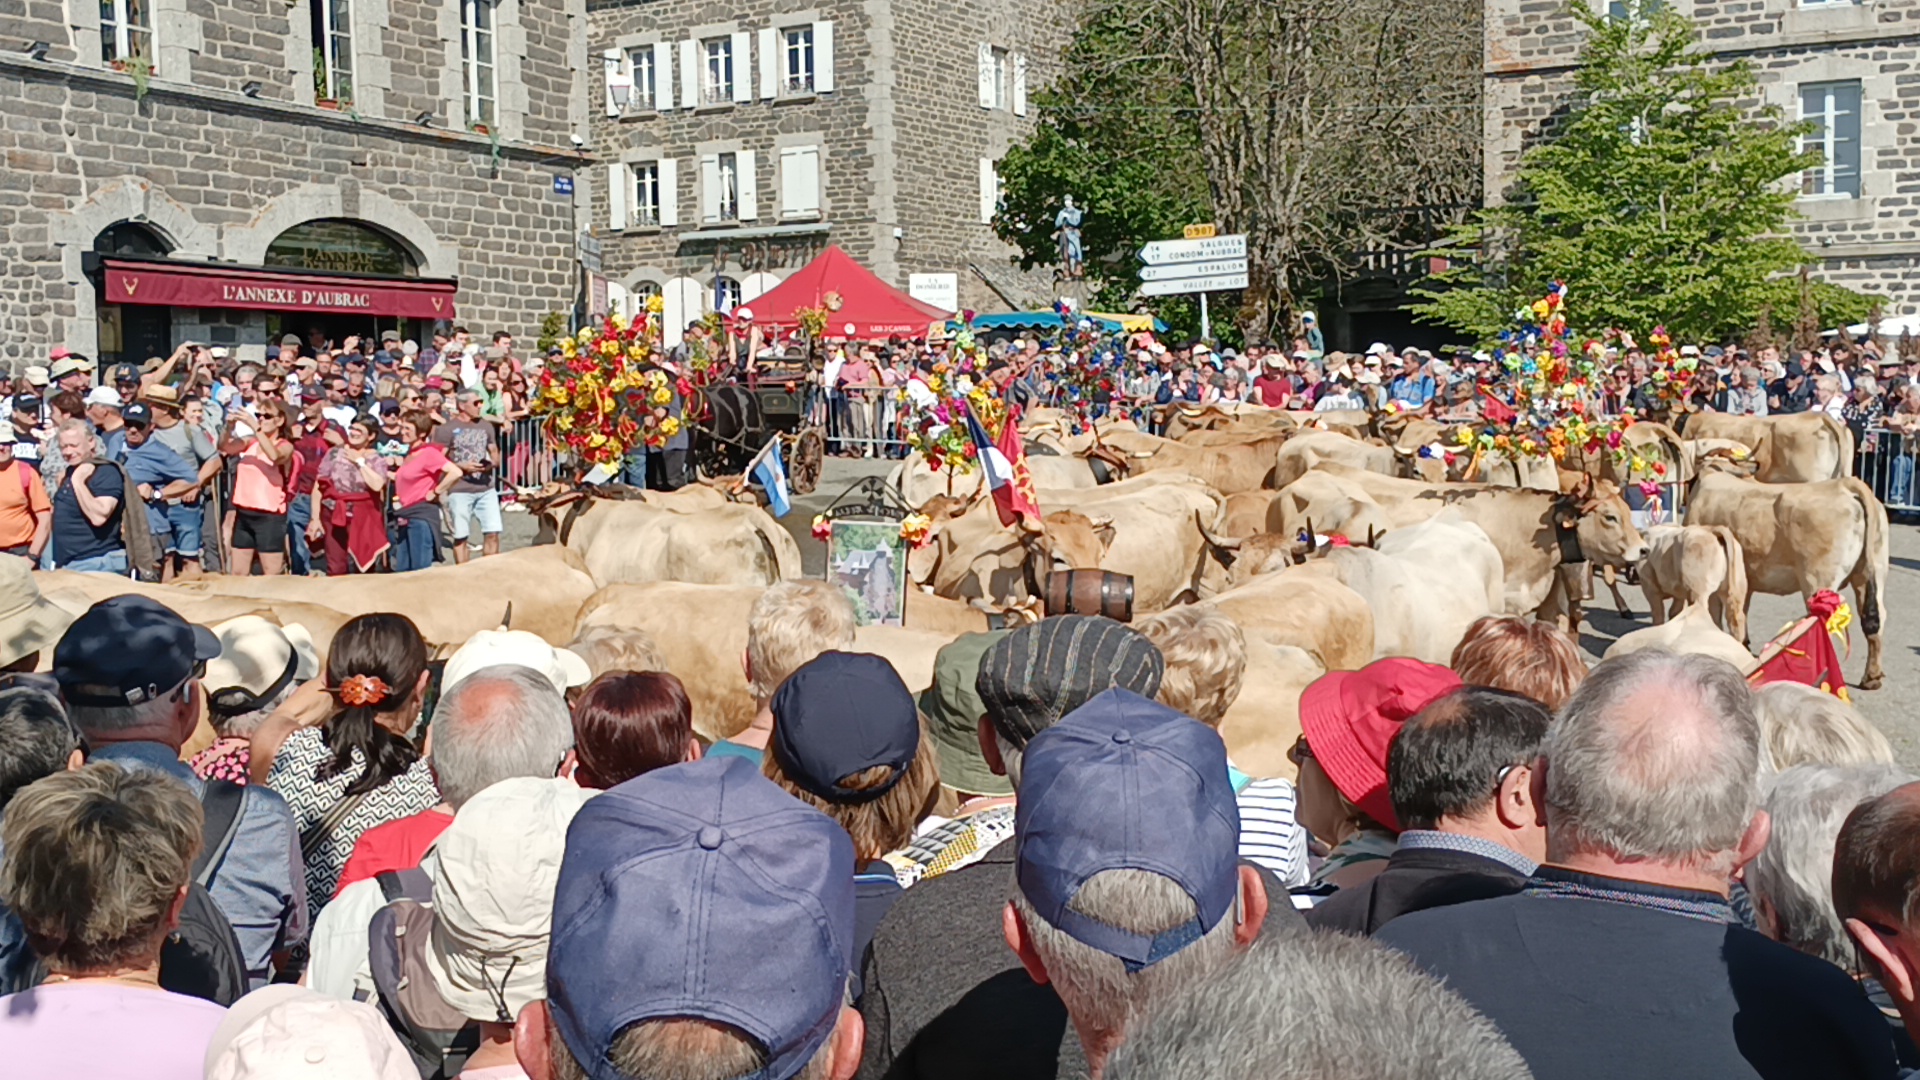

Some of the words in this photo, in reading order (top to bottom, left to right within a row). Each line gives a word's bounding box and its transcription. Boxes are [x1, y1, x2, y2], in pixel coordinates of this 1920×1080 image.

[1200, 239, 1243, 249] SALGUES
[1169, 251, 1204, 260] CONDOM
[1198, 263, 1244, 272] ESPALION
[1229, 277, 1245, 286] LOT
[223, 285, 297, 304] L'ANNEXE
[302, 290, 370, 307] D'AUBRAC
